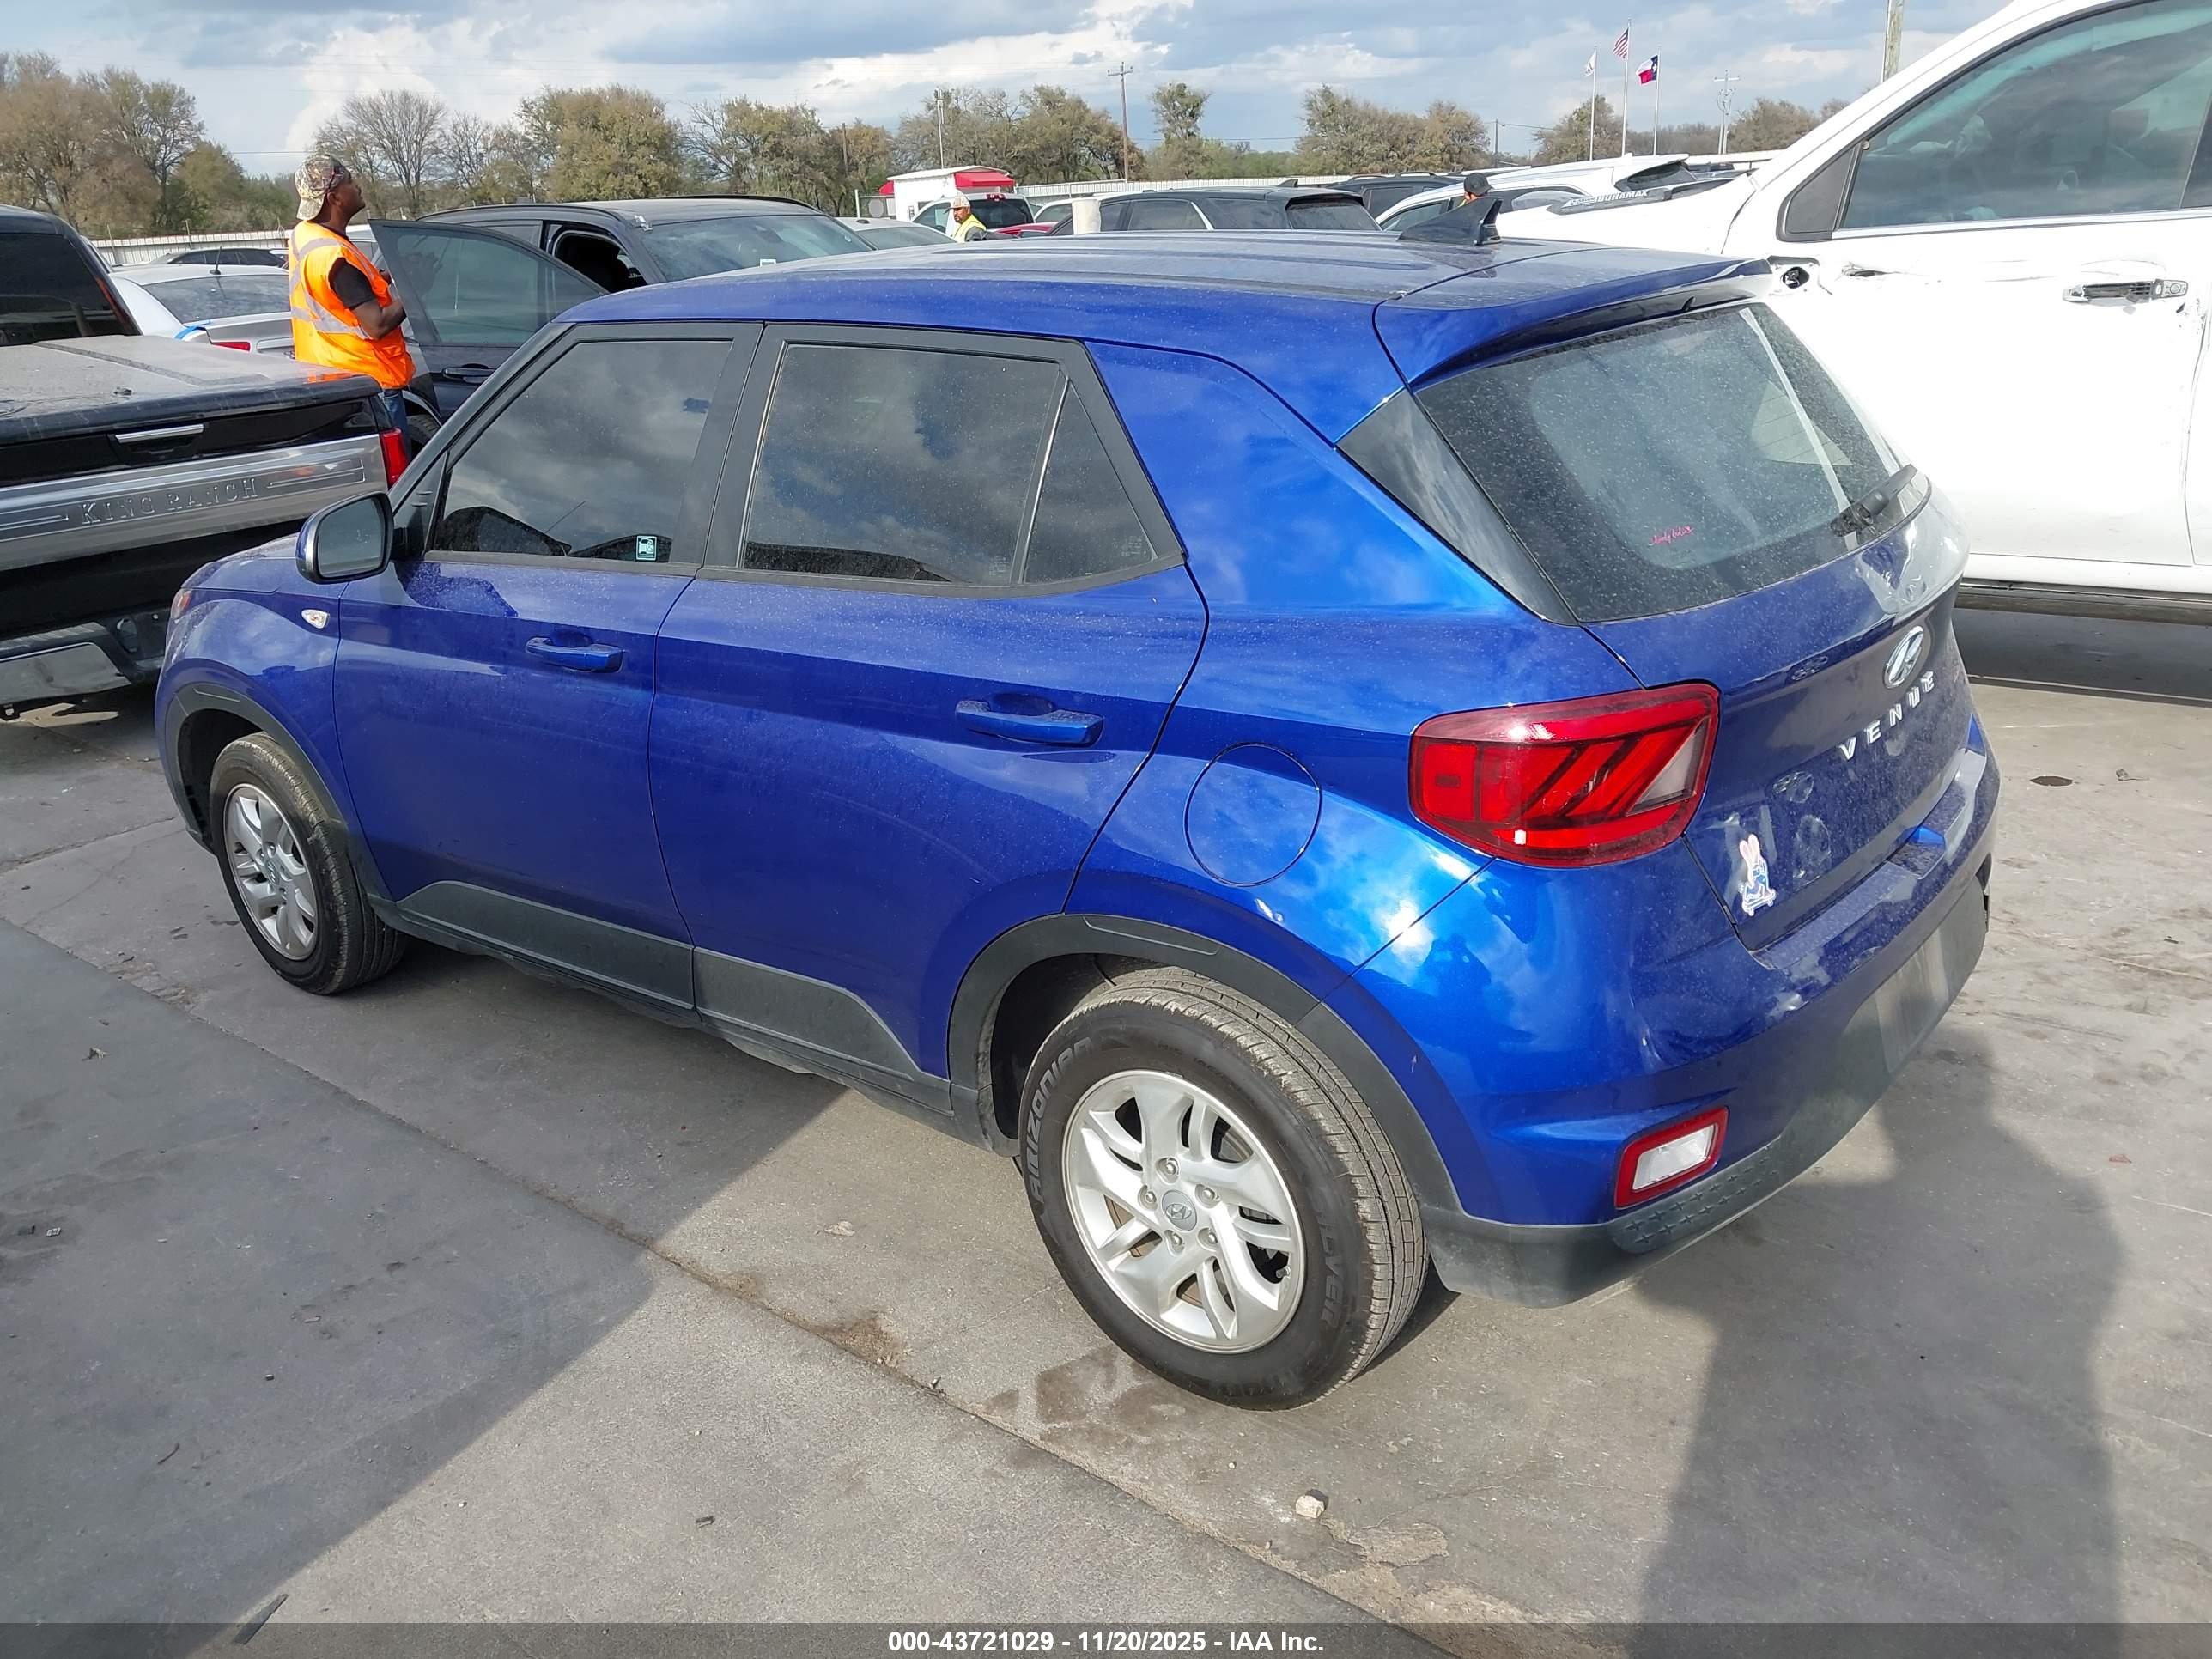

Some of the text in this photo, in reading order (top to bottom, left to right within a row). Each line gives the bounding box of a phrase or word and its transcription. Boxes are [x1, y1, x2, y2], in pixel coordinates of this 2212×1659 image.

[82, 477, 258, 525] KING RANCH
[1838, 671, 1935, 761] VENUE
[1026, 1036, 1092, 1203] ARIZONIAN
